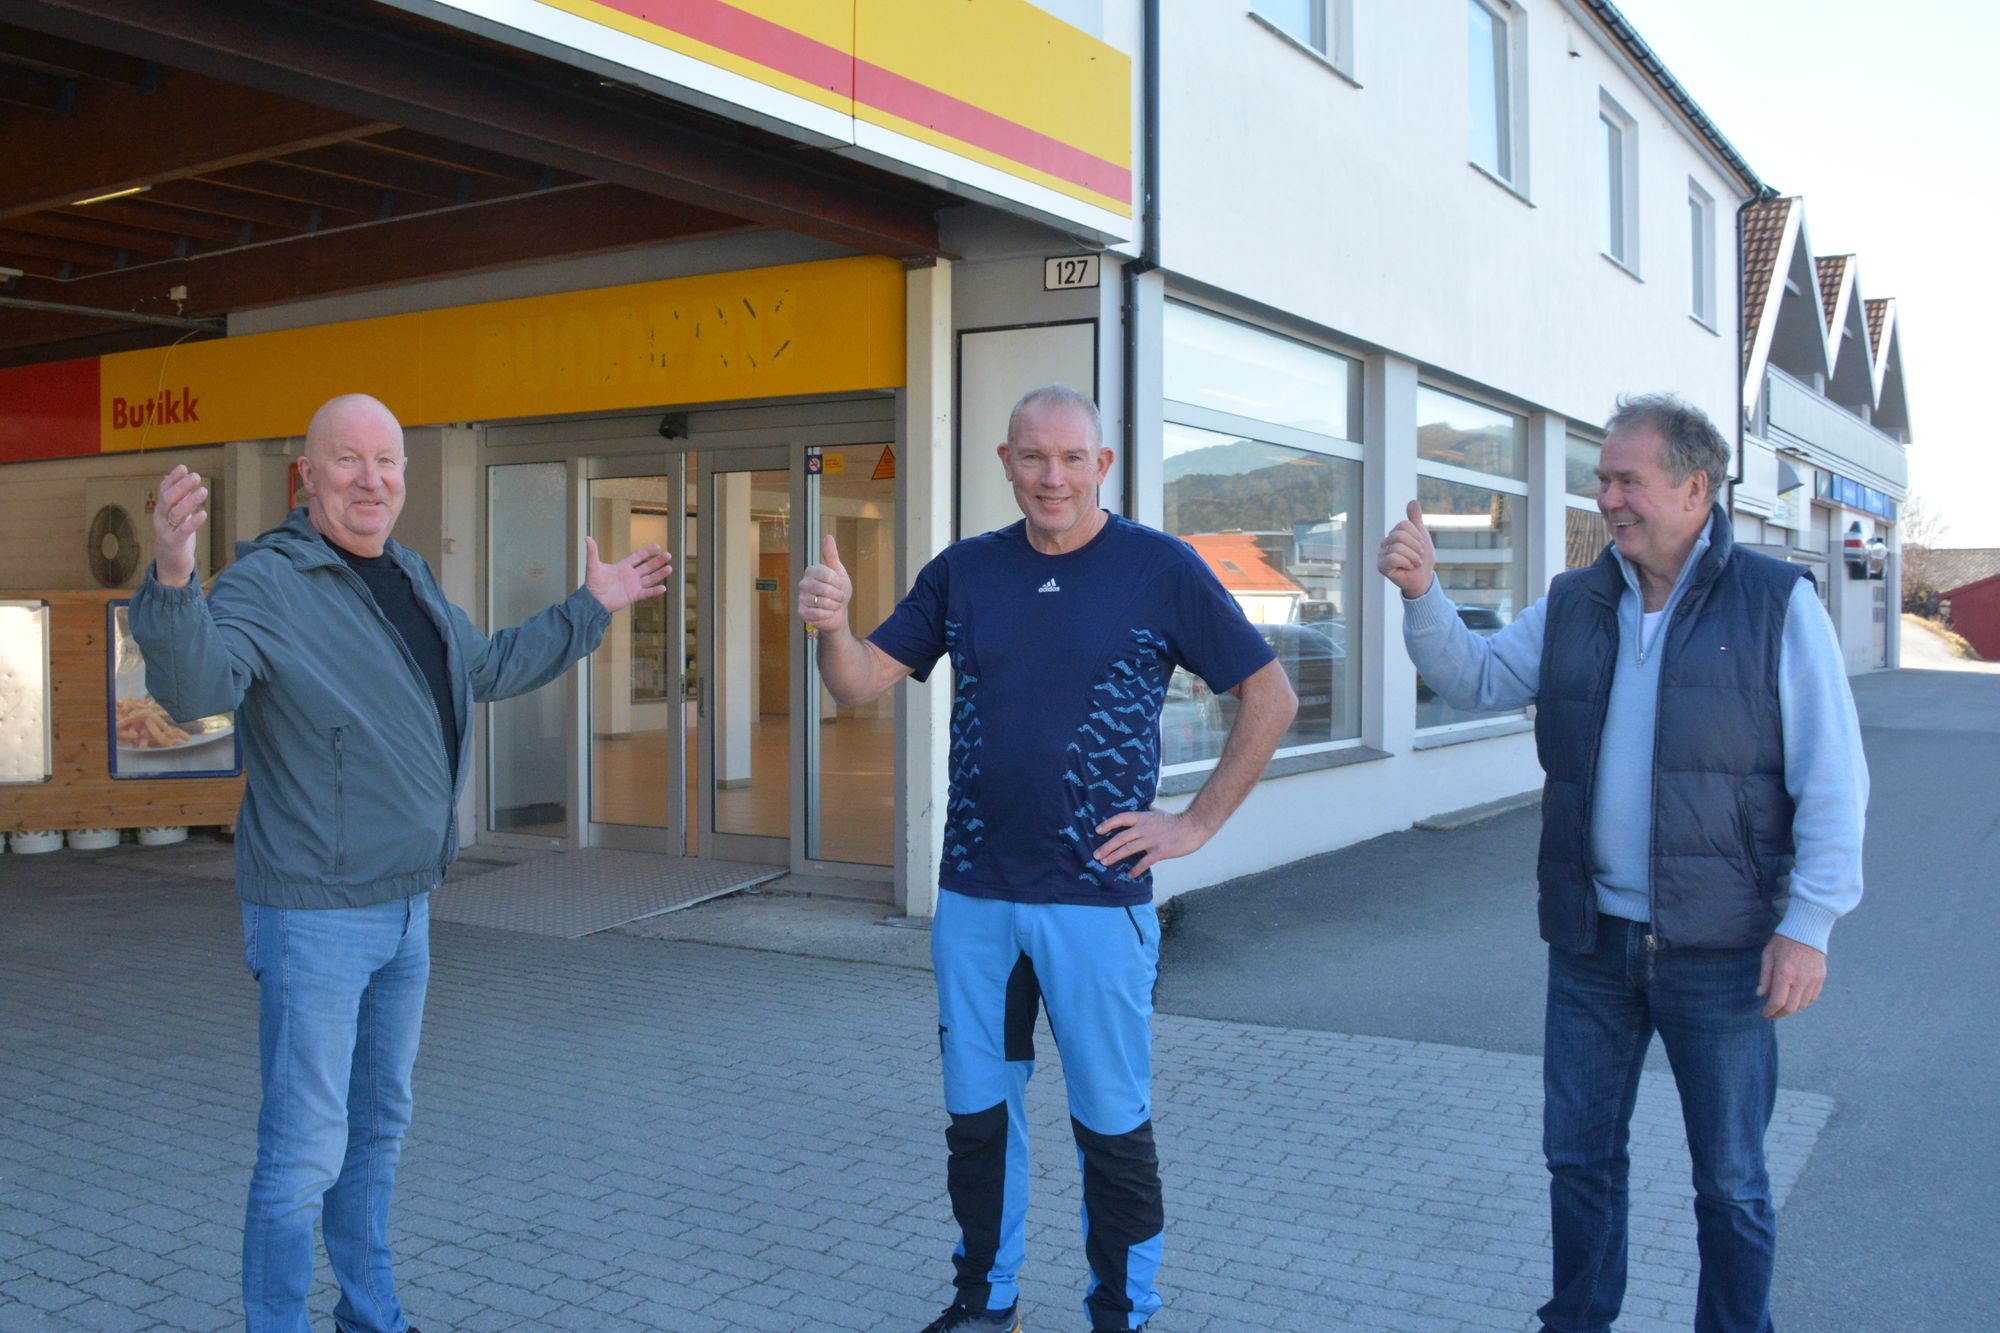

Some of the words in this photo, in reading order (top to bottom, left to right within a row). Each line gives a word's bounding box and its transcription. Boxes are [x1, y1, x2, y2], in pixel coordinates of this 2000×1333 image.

[1056, 260, 1089, 285] 127
[112, 386, 200, 430] Butikk
[1038, 585, 1060, 593] adidas
